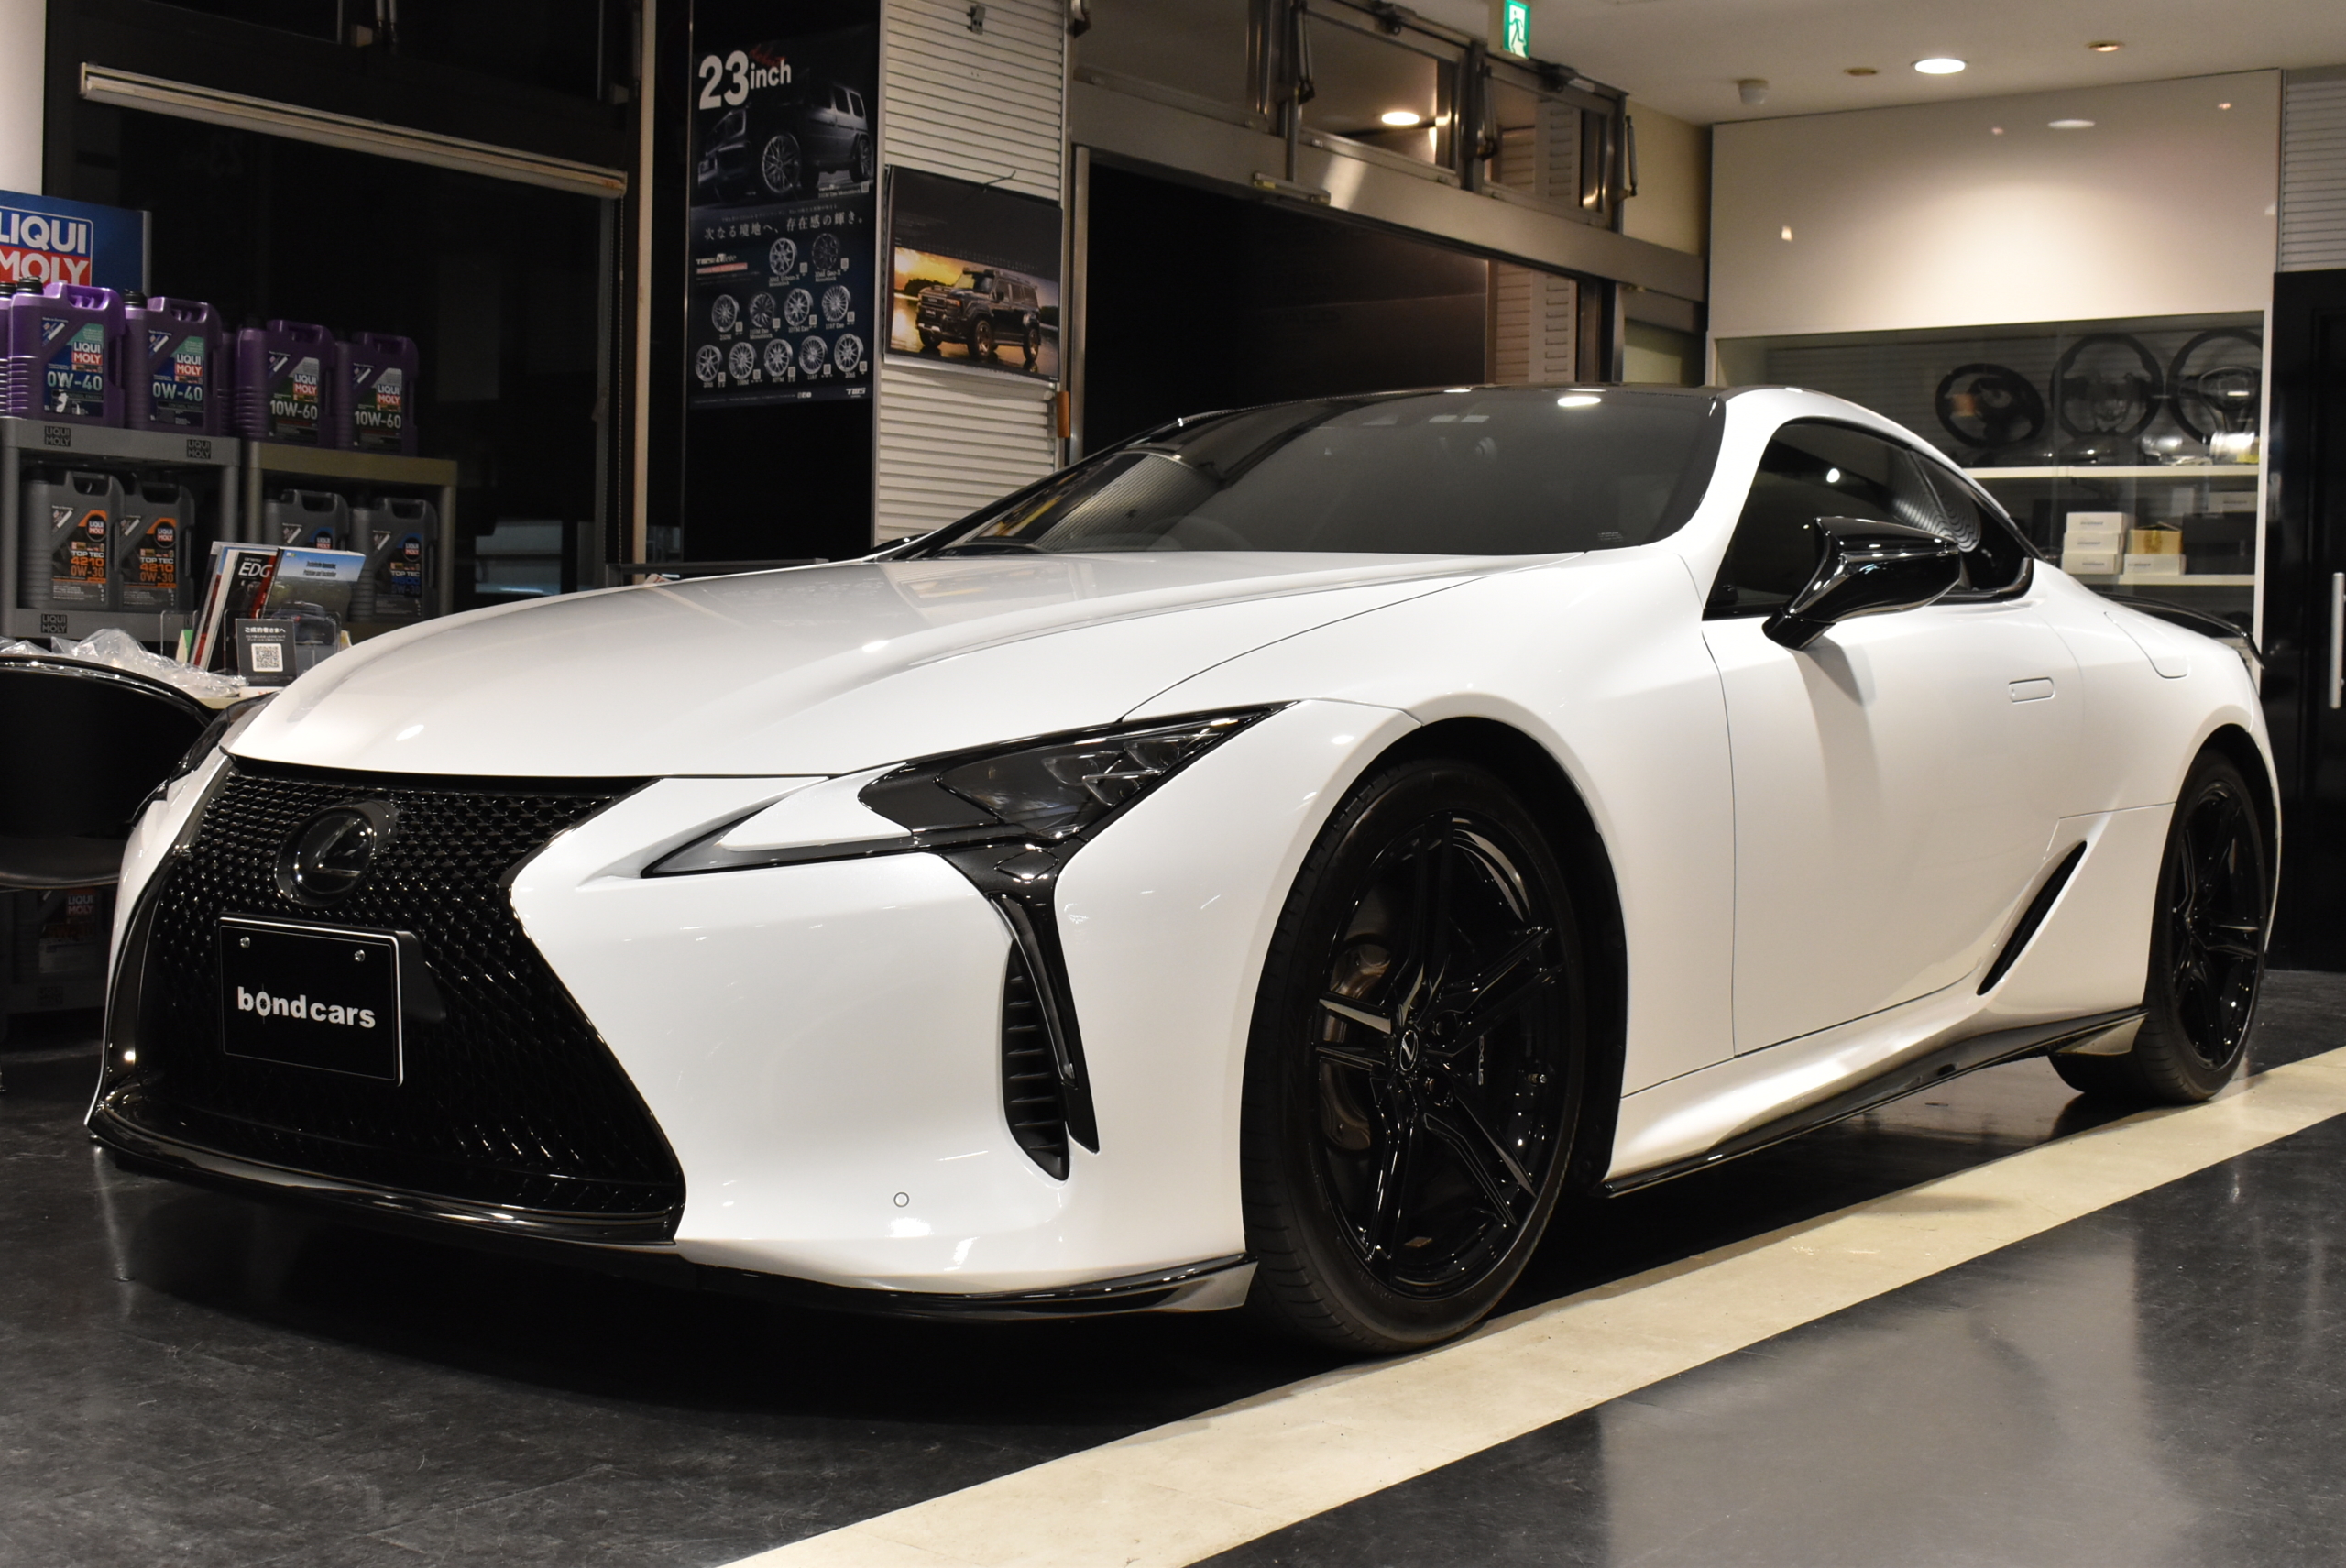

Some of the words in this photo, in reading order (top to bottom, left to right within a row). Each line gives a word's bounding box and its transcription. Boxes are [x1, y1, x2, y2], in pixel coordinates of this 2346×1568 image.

[698, 49, 750, 110] 23
[750, 58, 792, 90] inch
[0, 213, 87, 254] LIQUI
[0, 249, 89, 287] MOLY
[73, 342, 101, 354] LIQUI
[73, 353, 102, 365] MOLY
[176, 354, 202, 366] LIQUI
[176, 365, 203, 377] MOLY
[47, 371, 103, 391] 0W-40
[294, 374, 317, 385] LIQUI
[152, 381, 203, 402] 0W-40
[294, 384, 318, 395] MOLY
[378, 385, 400, 395] LIQUI
[378, 394, 400, 405] MOLY
[269, 400, 318, 421] 10W-60
[355, 411, 402, 430] 10W-60
[46, 427, 70, 436] LIQUI
[46, 436, 71, 446] MOLY
[187, 440, 211, 450] LIQUI
[187, 449, 211, 459] MOLY
[71, 557, 104, 567] 4210
[71, 566, 104, 577] 0W-30
[139, 564, 174, 573] 4210
[139, 572, 174, 583] 0W-30
[42, 615, 67, 624] LIQUI
[42, 623, 67, 633] MOLY
[68, 894, 93, 905] LIQUI
[68, 905, 93, 915] MOLY
